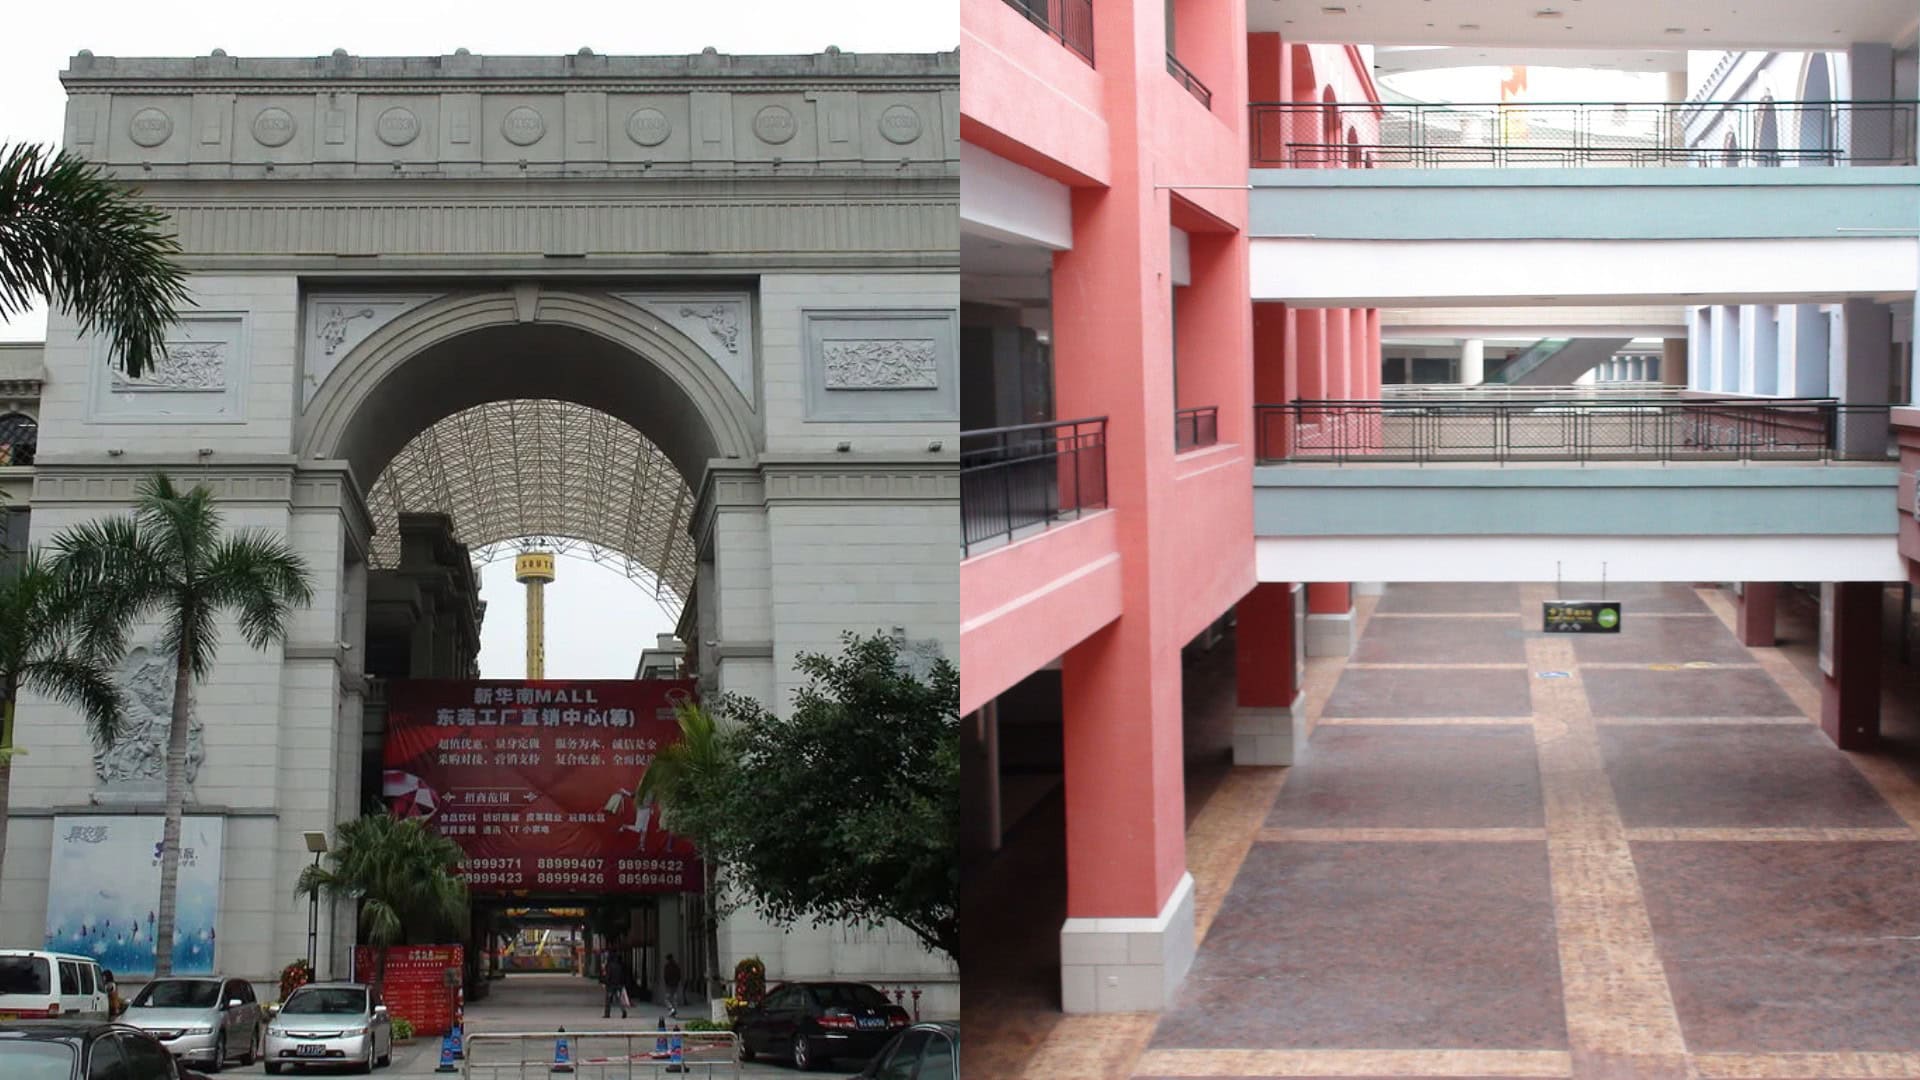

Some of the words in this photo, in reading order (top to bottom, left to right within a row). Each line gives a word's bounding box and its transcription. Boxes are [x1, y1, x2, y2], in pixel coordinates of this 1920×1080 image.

[474, 687, 598, 704] 新华南MALL
[537, 858, 604, 869] 88999407
[537, 872, 605, 884] 88999426
